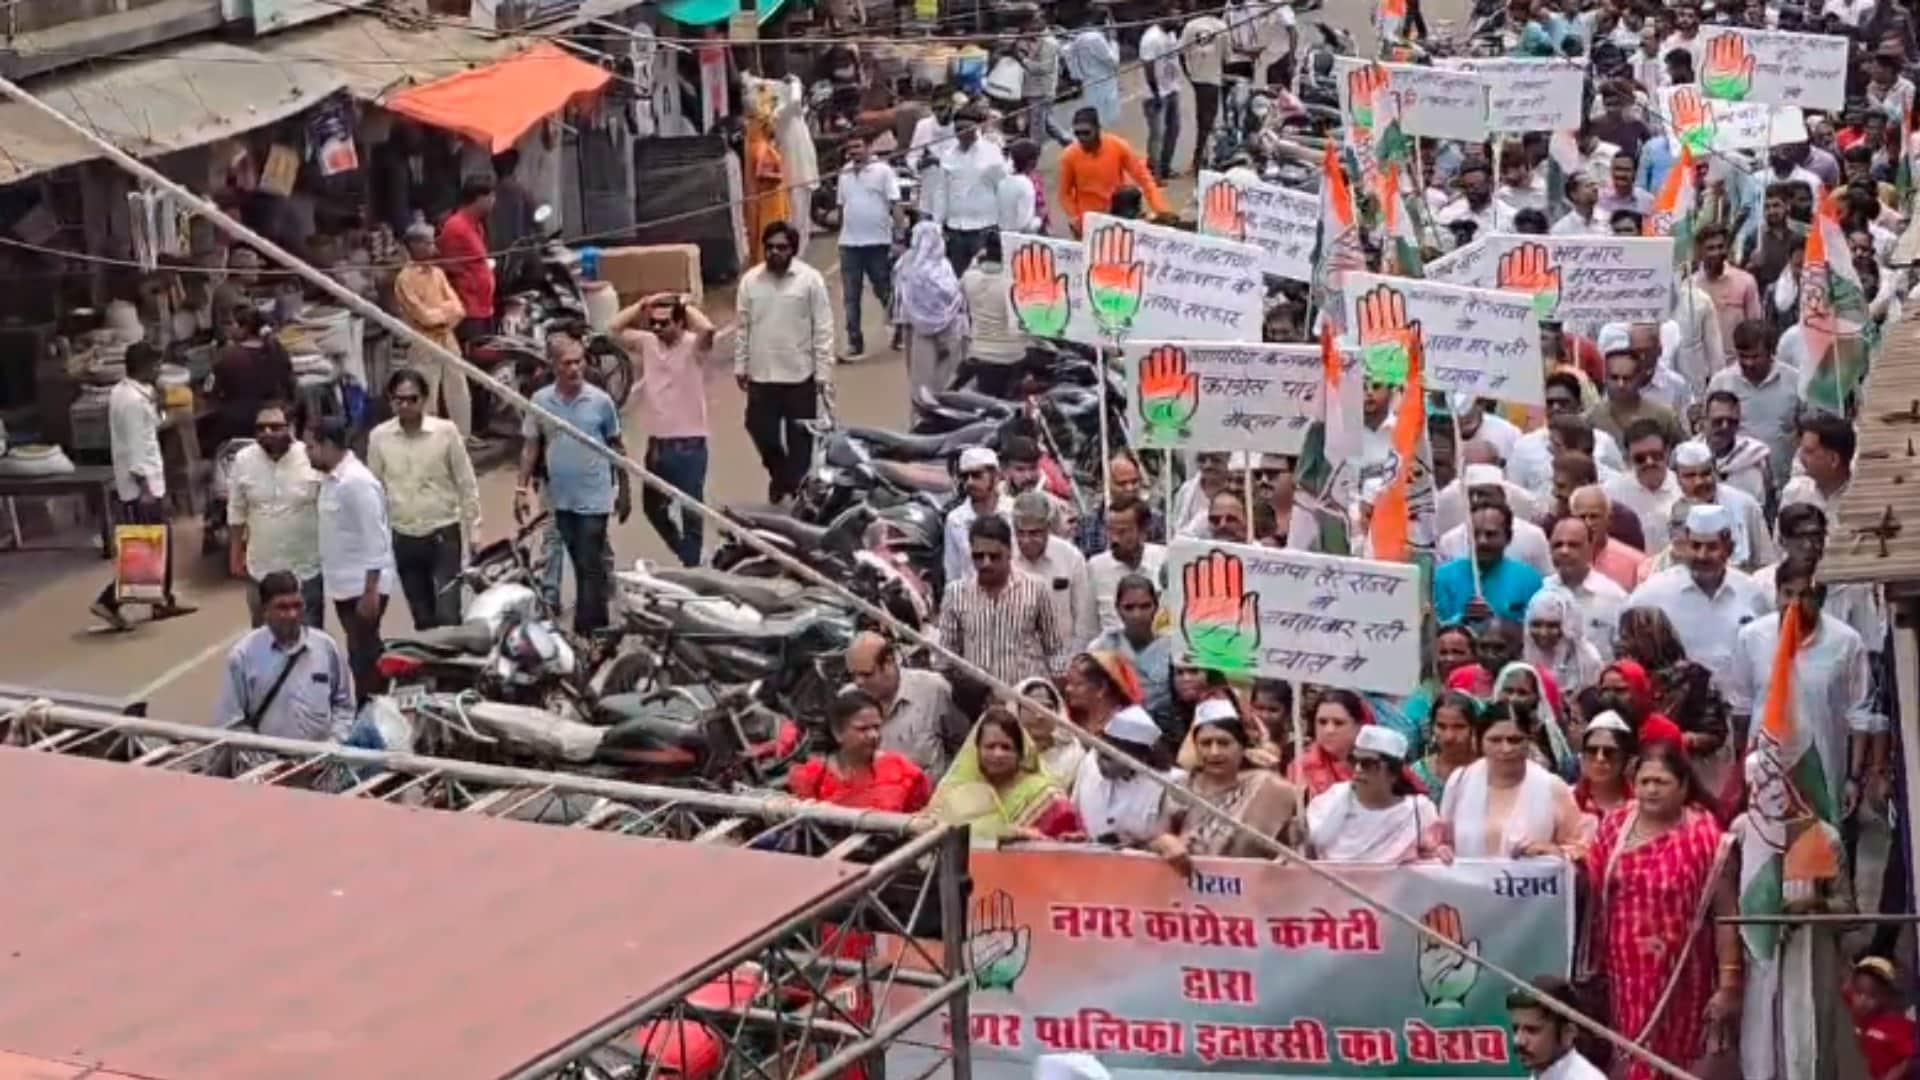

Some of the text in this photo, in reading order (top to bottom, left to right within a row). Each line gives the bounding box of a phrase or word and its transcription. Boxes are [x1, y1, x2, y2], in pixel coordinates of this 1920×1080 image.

[1493, 873, 1559, 898] घेराव
[1050, 902, 1382, 951] नगर कांग्रेस कमेटी
[1181, 966, 1255, 1003] द्वारा
[1033, 1008, 1184, 1055] पालिका
[1195, 1018, 1328, 1062] इटारसी
[1336, 1027, 1396, 1064] का
[1405, 1020, 1508, 1064] घेराव
